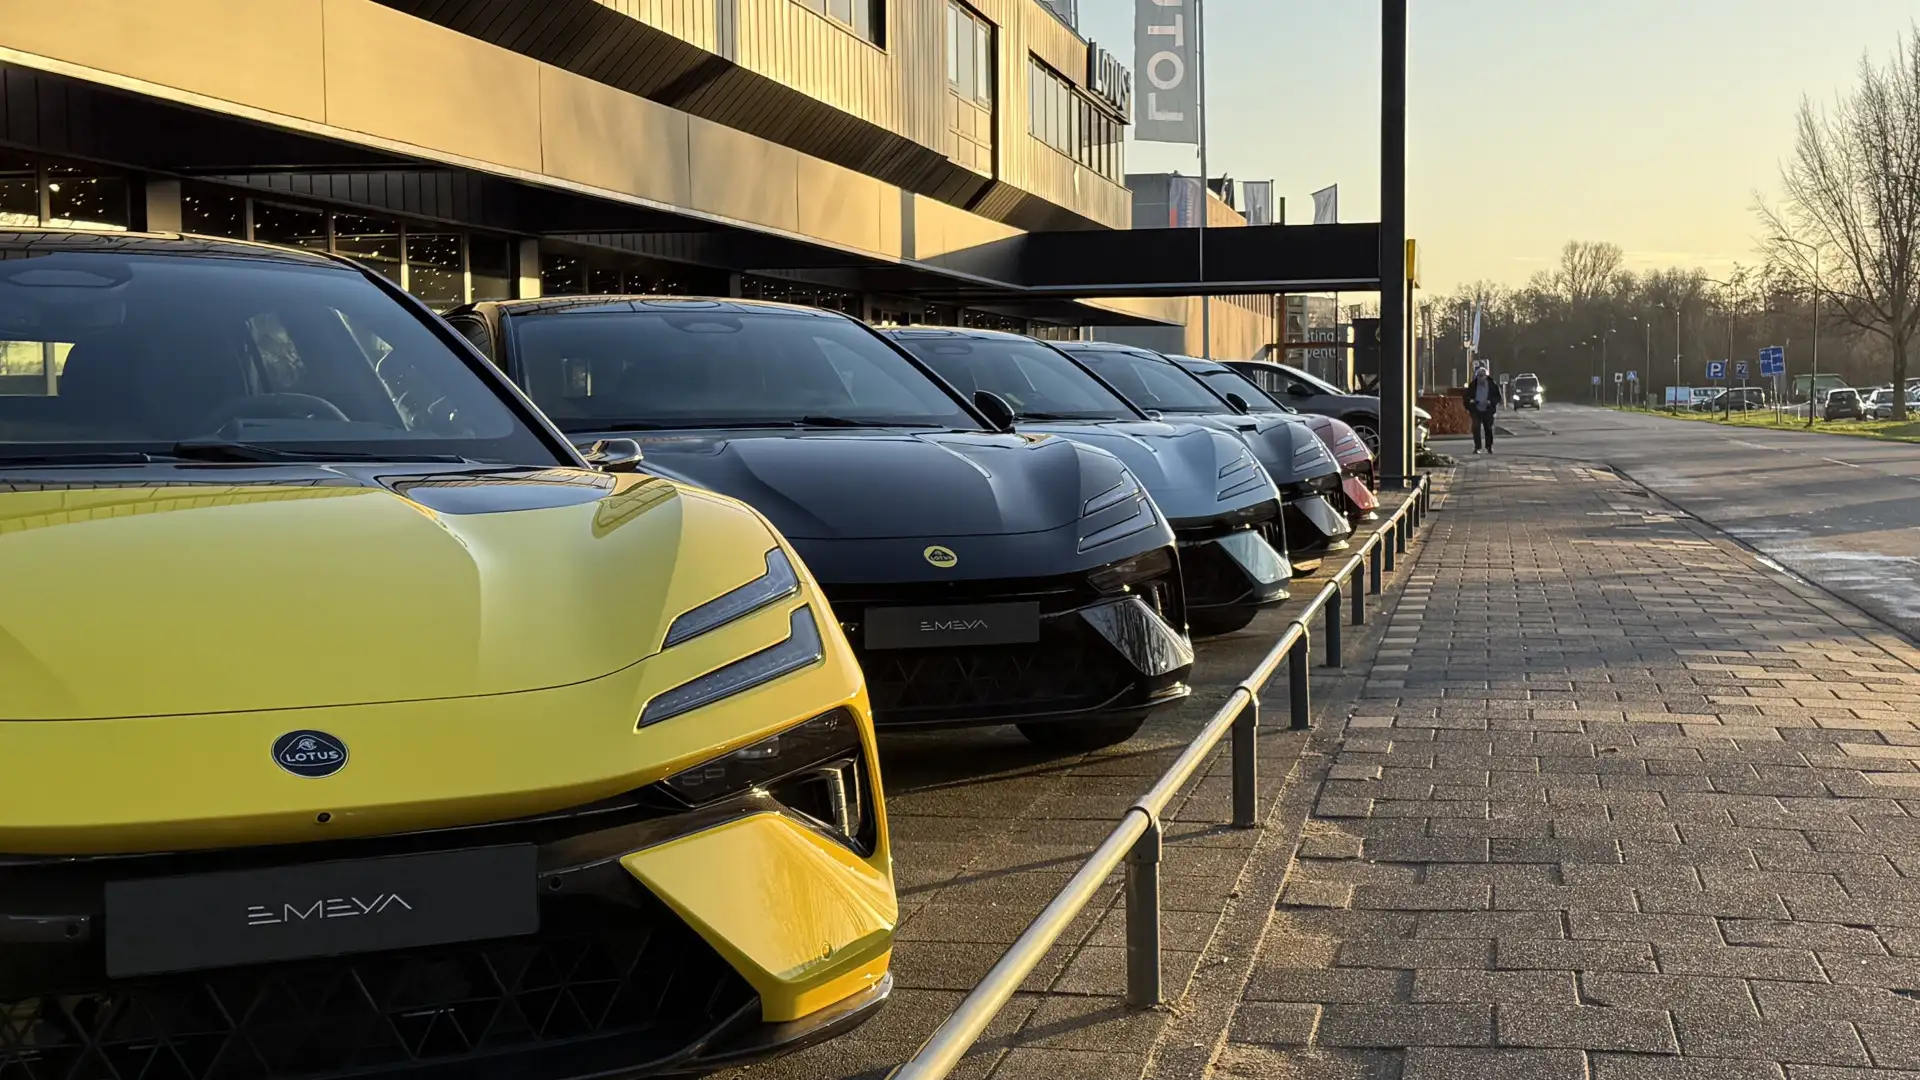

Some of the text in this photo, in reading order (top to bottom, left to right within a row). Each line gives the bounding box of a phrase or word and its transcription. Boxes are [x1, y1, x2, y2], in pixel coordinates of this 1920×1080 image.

[1094, 41, 1128, 111] LOTUS
[1147, 0, 1184, 121] LOT
[1710, 362, 1722, 377] P
[285, 750, 339, 762] LOTUS
[248, 893, 412, 925] EMEYA
